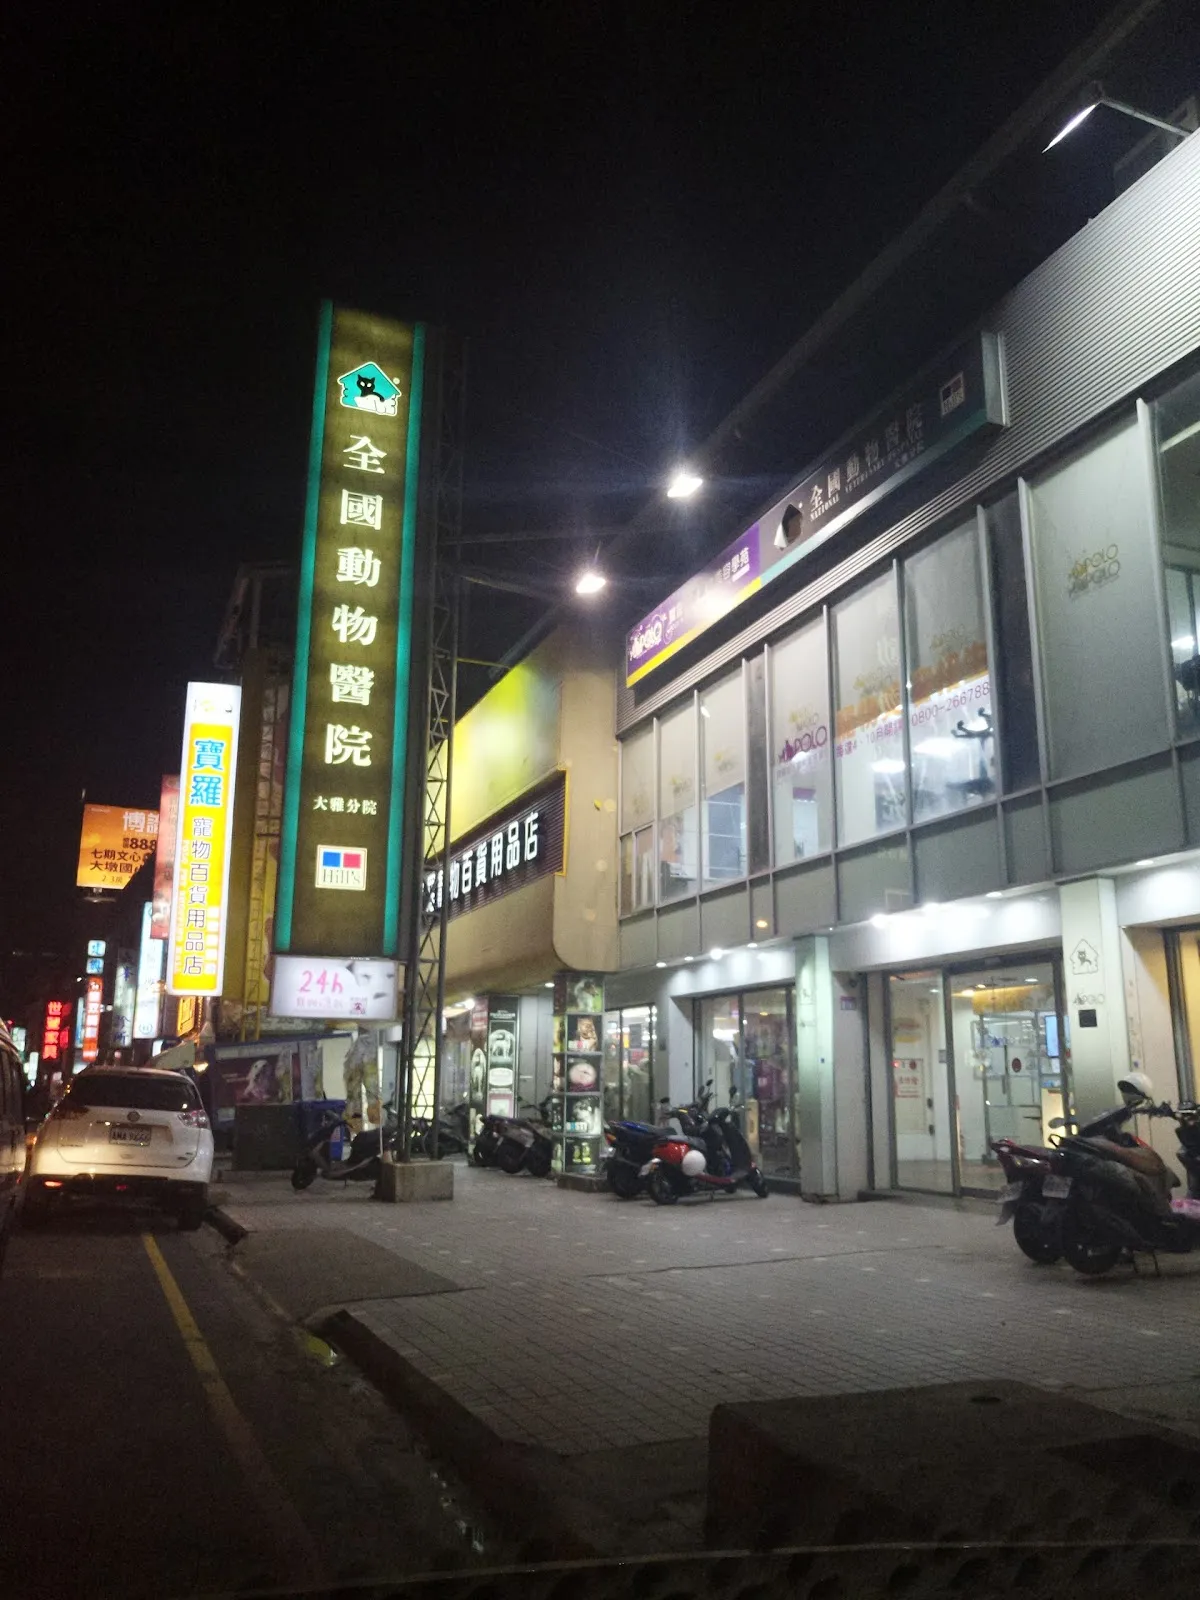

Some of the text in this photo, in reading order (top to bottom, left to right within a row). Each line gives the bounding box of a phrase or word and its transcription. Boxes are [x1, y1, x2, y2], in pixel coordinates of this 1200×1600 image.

[323, 434, 388, 768] 全國動物醫院
[190, 740, 224, 806] 寶羅
[313, 794, 378, 816] 大雅分院
[183, 818, 212, 975] 寵物百貨用品店
[321, 867, 362, 886] Hill's
[298, 969, 344, 994] 24h
